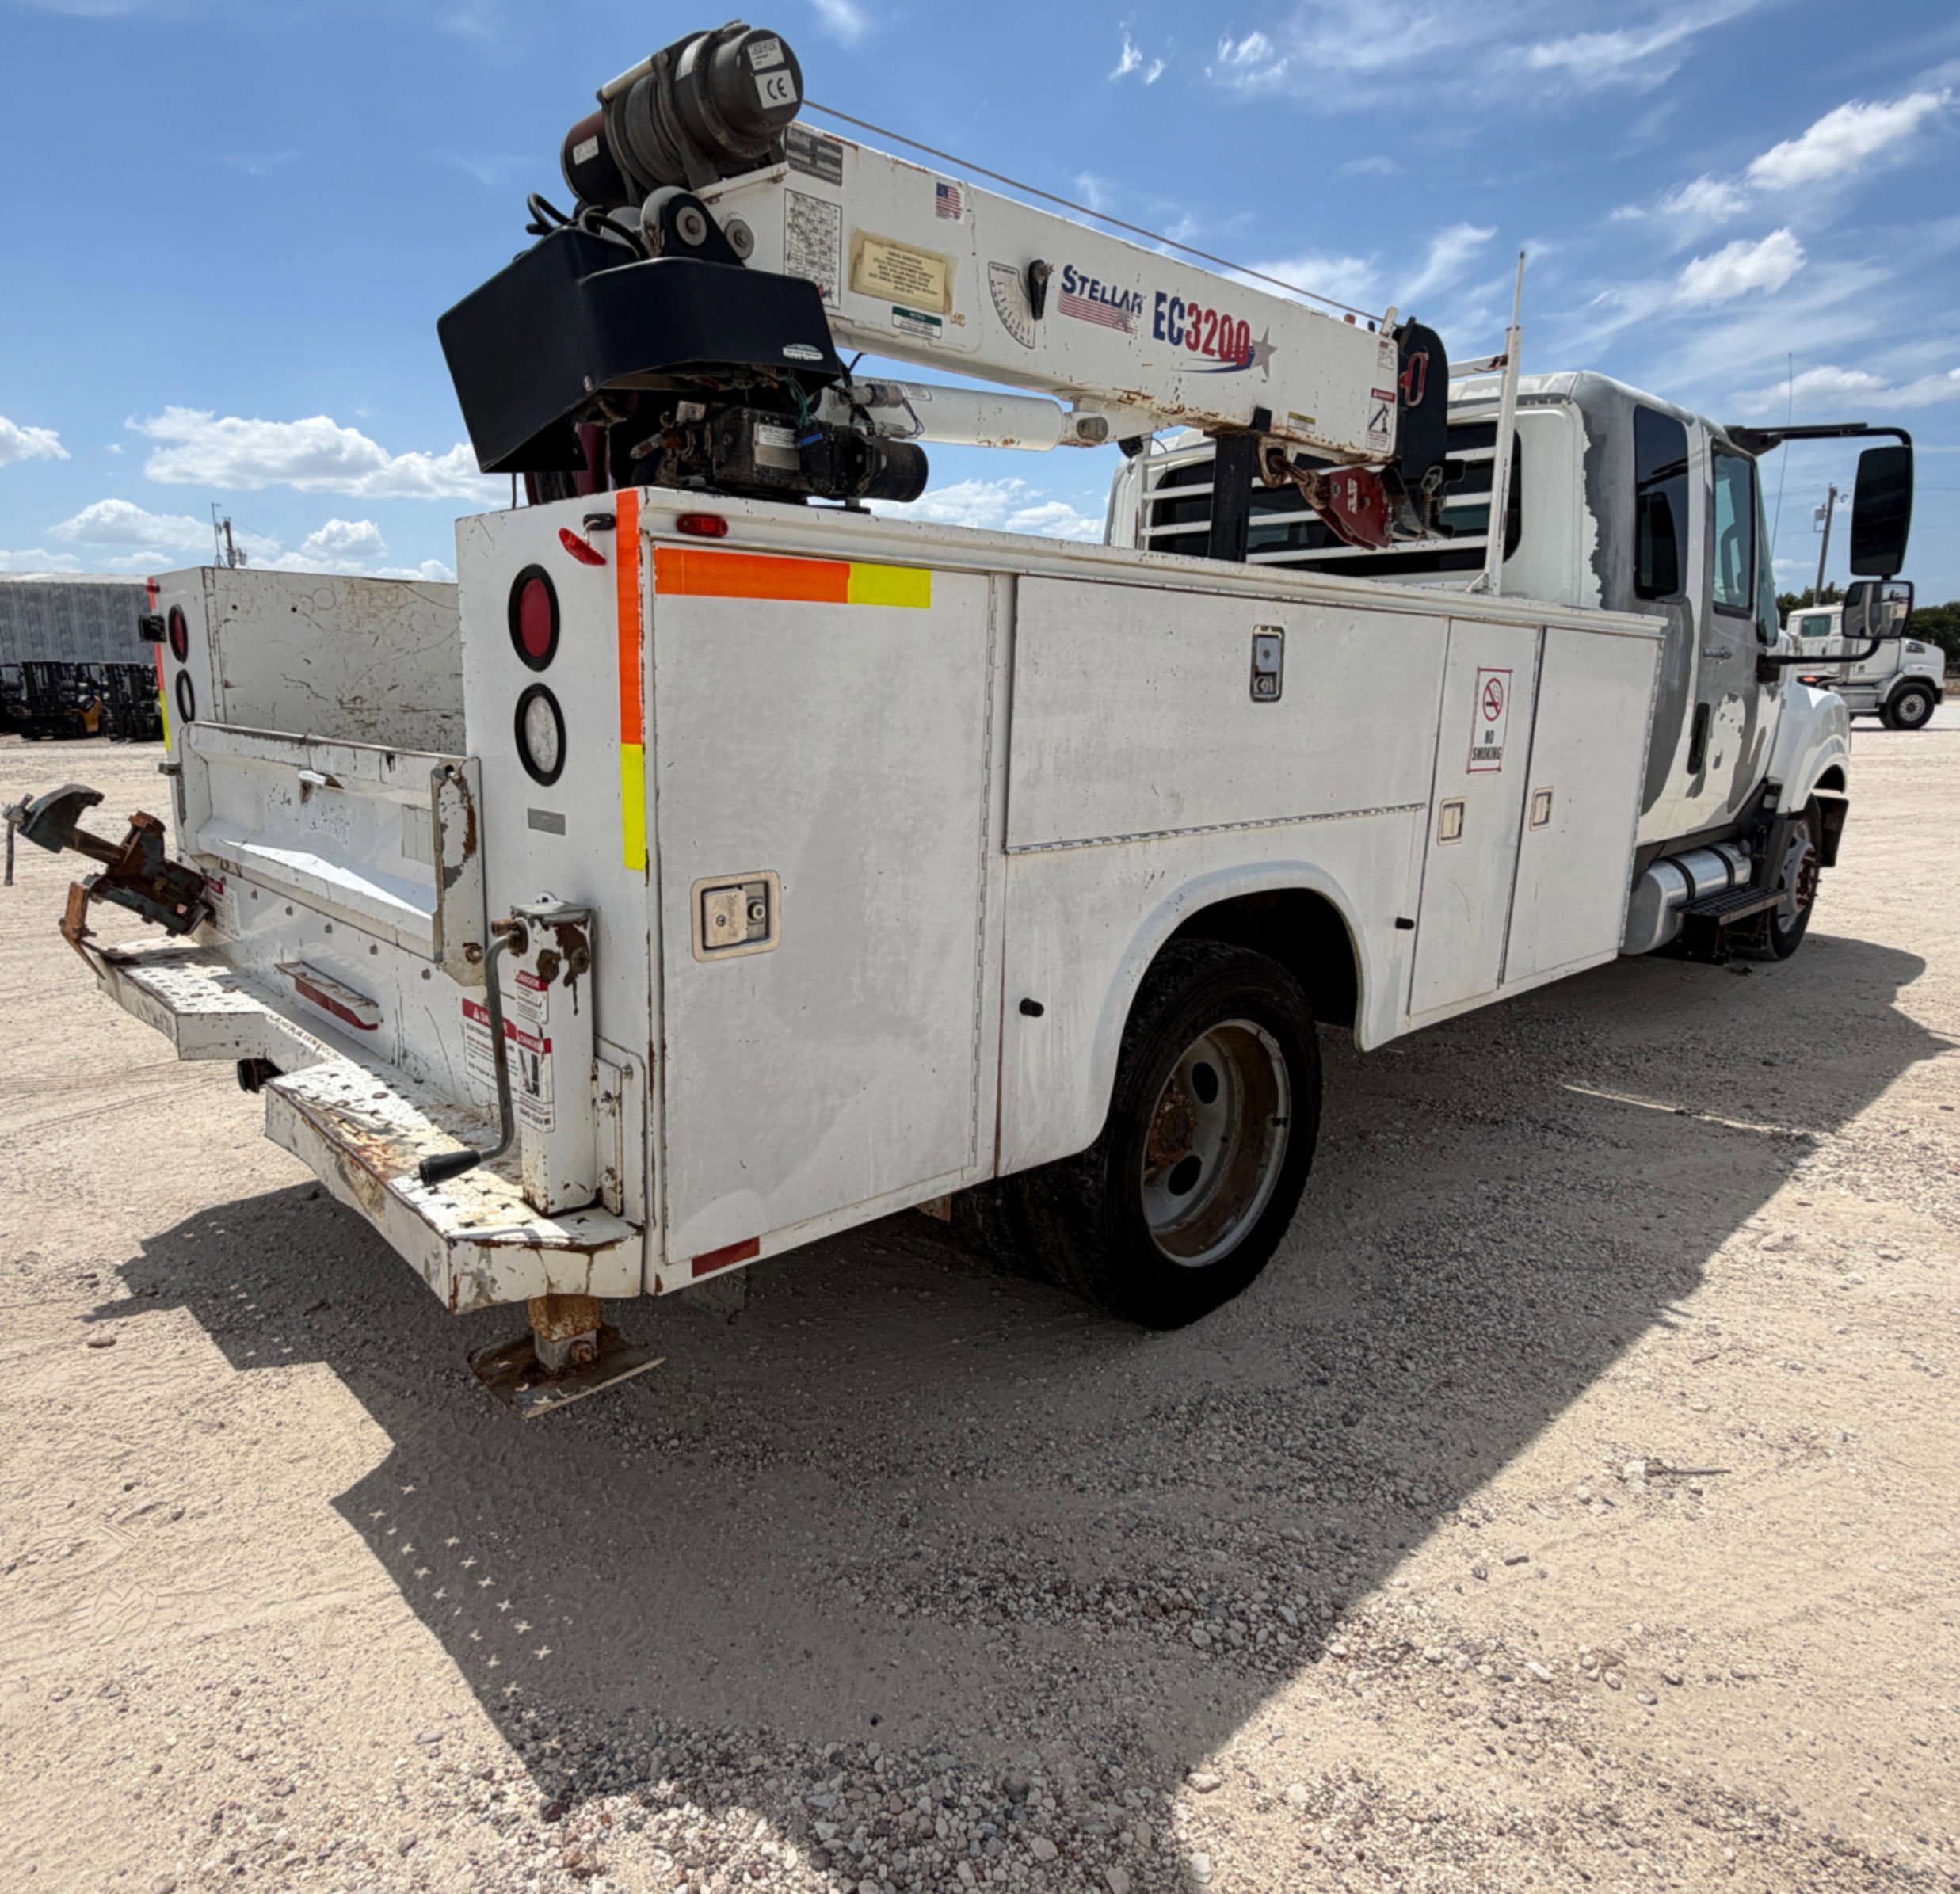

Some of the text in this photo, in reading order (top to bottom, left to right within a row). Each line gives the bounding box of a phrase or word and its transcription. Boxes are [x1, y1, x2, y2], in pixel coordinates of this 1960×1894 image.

[766, 77, 787, 101] CE
[1061, 265, 1142, 314] STELLAR
[1153, 290, 1250, 366] EC3200
[1484, 730, 1495, 744] NO
[1472, 746, 1502, 760] SMOKING
